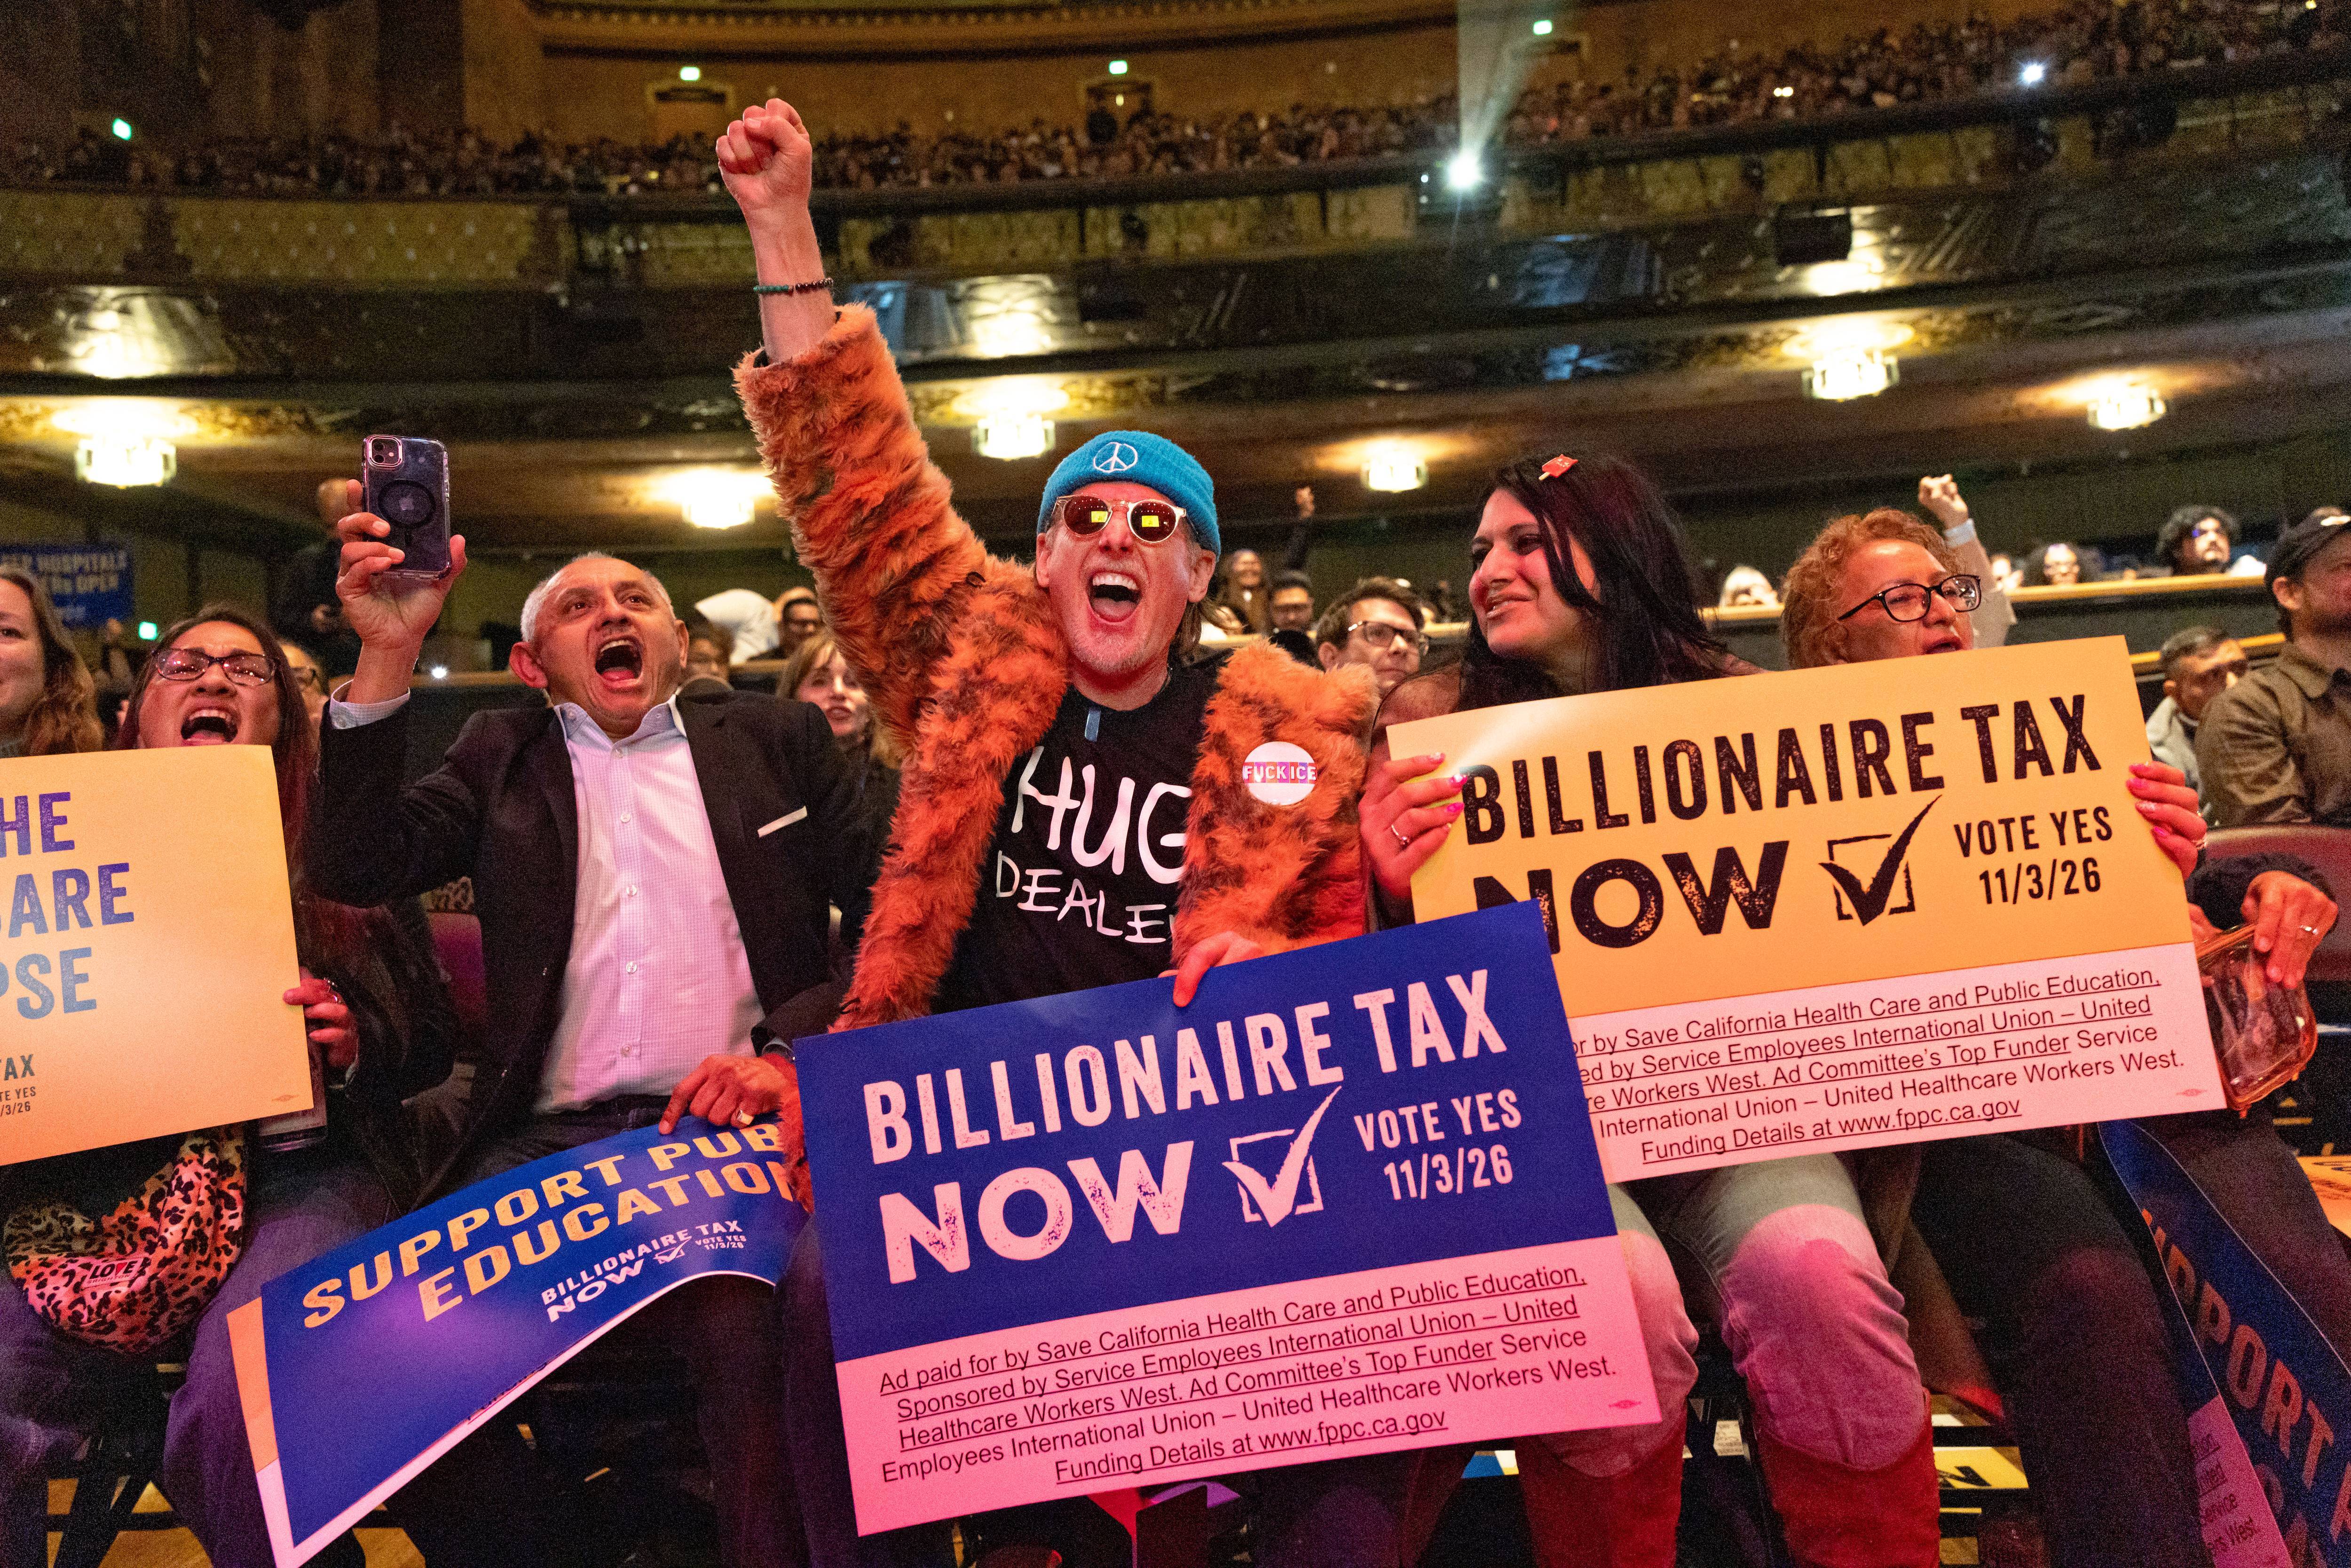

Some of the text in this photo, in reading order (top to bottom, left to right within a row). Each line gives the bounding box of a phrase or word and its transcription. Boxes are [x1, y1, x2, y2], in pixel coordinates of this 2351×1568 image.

[1243, 765, 1316, 780] FUCK ICE
[1460, 694, 2102, 845] BILLIONAIRE TAX
[1011, 746, 1192, 884] HUG
[1953, 806, 2112, 858] VOTE YES
[0, 862, 134, 938] ARE
[1474, 840, 1790, 954] NOW
[1979, 857, 2101, 905] 11/3/26
[1593, 1033, 1617, 1054] by
[1625, 1028, 1679, 1048] Save
[1686, 1014, 1787, 1040] California
[1793, 1001, 1862, 1026] Health
[1869, 997, 1921, 1017] Care
[1928, 987, 1967, 1010] and
[1974, 981, 2040, 1004] Public
[2046, 970, 2160, 996] Education,
[1610, 1060, 1635, 1084] by
[1642, 1051, 1720, 1074] Service
[1728, 1035, 1846, 1063] Employees
[1853, 1014, 1985, 1047] International
[1991, 1010, 2054, 1031] Union
[2081, 994, 2151, 1020] United
[0, 1054, 35, 1081] AX
[15, 1086, 36, 1099] YES
[863, 969, 1507, 1165] BILLIONAIRE TAX
[1600, 1102, 1728, 1138] International
[1735, 1098, 1797, 1119] Union
[1824, 1081, 1894, 1107] United
[1901, 1072, 2017, 1098] Healthcare
[2023, 1060, 2115, 1083] Workers
[2120, 1049, 2184, 1072] West.
[1611, 1082, 1700, 1107] Workers
[1705, 1070, 1766, 1094] West.
[1773, 1064, 1801, 1086] Ad
[1947, 1044, 1987, 1064] Top
[1993, 1034, 2069, 1059] Funder
[2076, 1026, 2158, 1049] Service
[1354, 1088, 1522, 1152] VOTE YES
[1641, 1099, 2020, 1161] Funding Details at www.fppc.ca.gov
[879, 1140, 1194, 1284] NOW
[1384, 1144, 1514, 1201] 11/3/26
[302, 1154, 625, 1329] SUPPORT
[541, 1220, 743, 1305] BILLIONAIRE TAX
[695, 1236, 724, 1246] VOTE
[546, 1259, 645, 1322] NOW
[880, 1266, 1585, 1394] Ad paid for by Save California Health Care and Public Education,
[897, 1378, 1015, 1424] Sponsored
[1022, 1375, 1047, 1400] by
[1055, 1363, 1135, 1389] Service
[1142, 1343, 1262, 1375] Employees
[1268, 1317, 1404, 1355] International
[1409, 1311, 1476, 1335] Union
[1503, 1294, 1578, 1323] United
[899, 1412, 1018, 1449] Healthcare
[1023, 1396, 1115, 1425] Workers
[1120, 1382, 1185, 1408] West.
[1189, 1375, 1218, 1399] Ad
[1365, 1351, 1407, 1372] Top
[1413, 1339, 1493, 1367] Funder
[1500, 1328, 1587, 1355] Service
[2142, 1208, 2334, 1489] PPORT
[882, 1445, 1004, 1483] Employees
[1011, 1417, 1145, 1458] International
[1152, 1411, 1215, 1435] Union
[1242, 1392, 1314, 1421] United
[1320, 1380, 1441, 1410] Healthcare
[1446, 1367, 1543, 1393] Workers
[1547, 1356, 1617, 1381] West.
[1055, 1410, 1445, 1481] Funding Details at www.fppc.ca.gov
